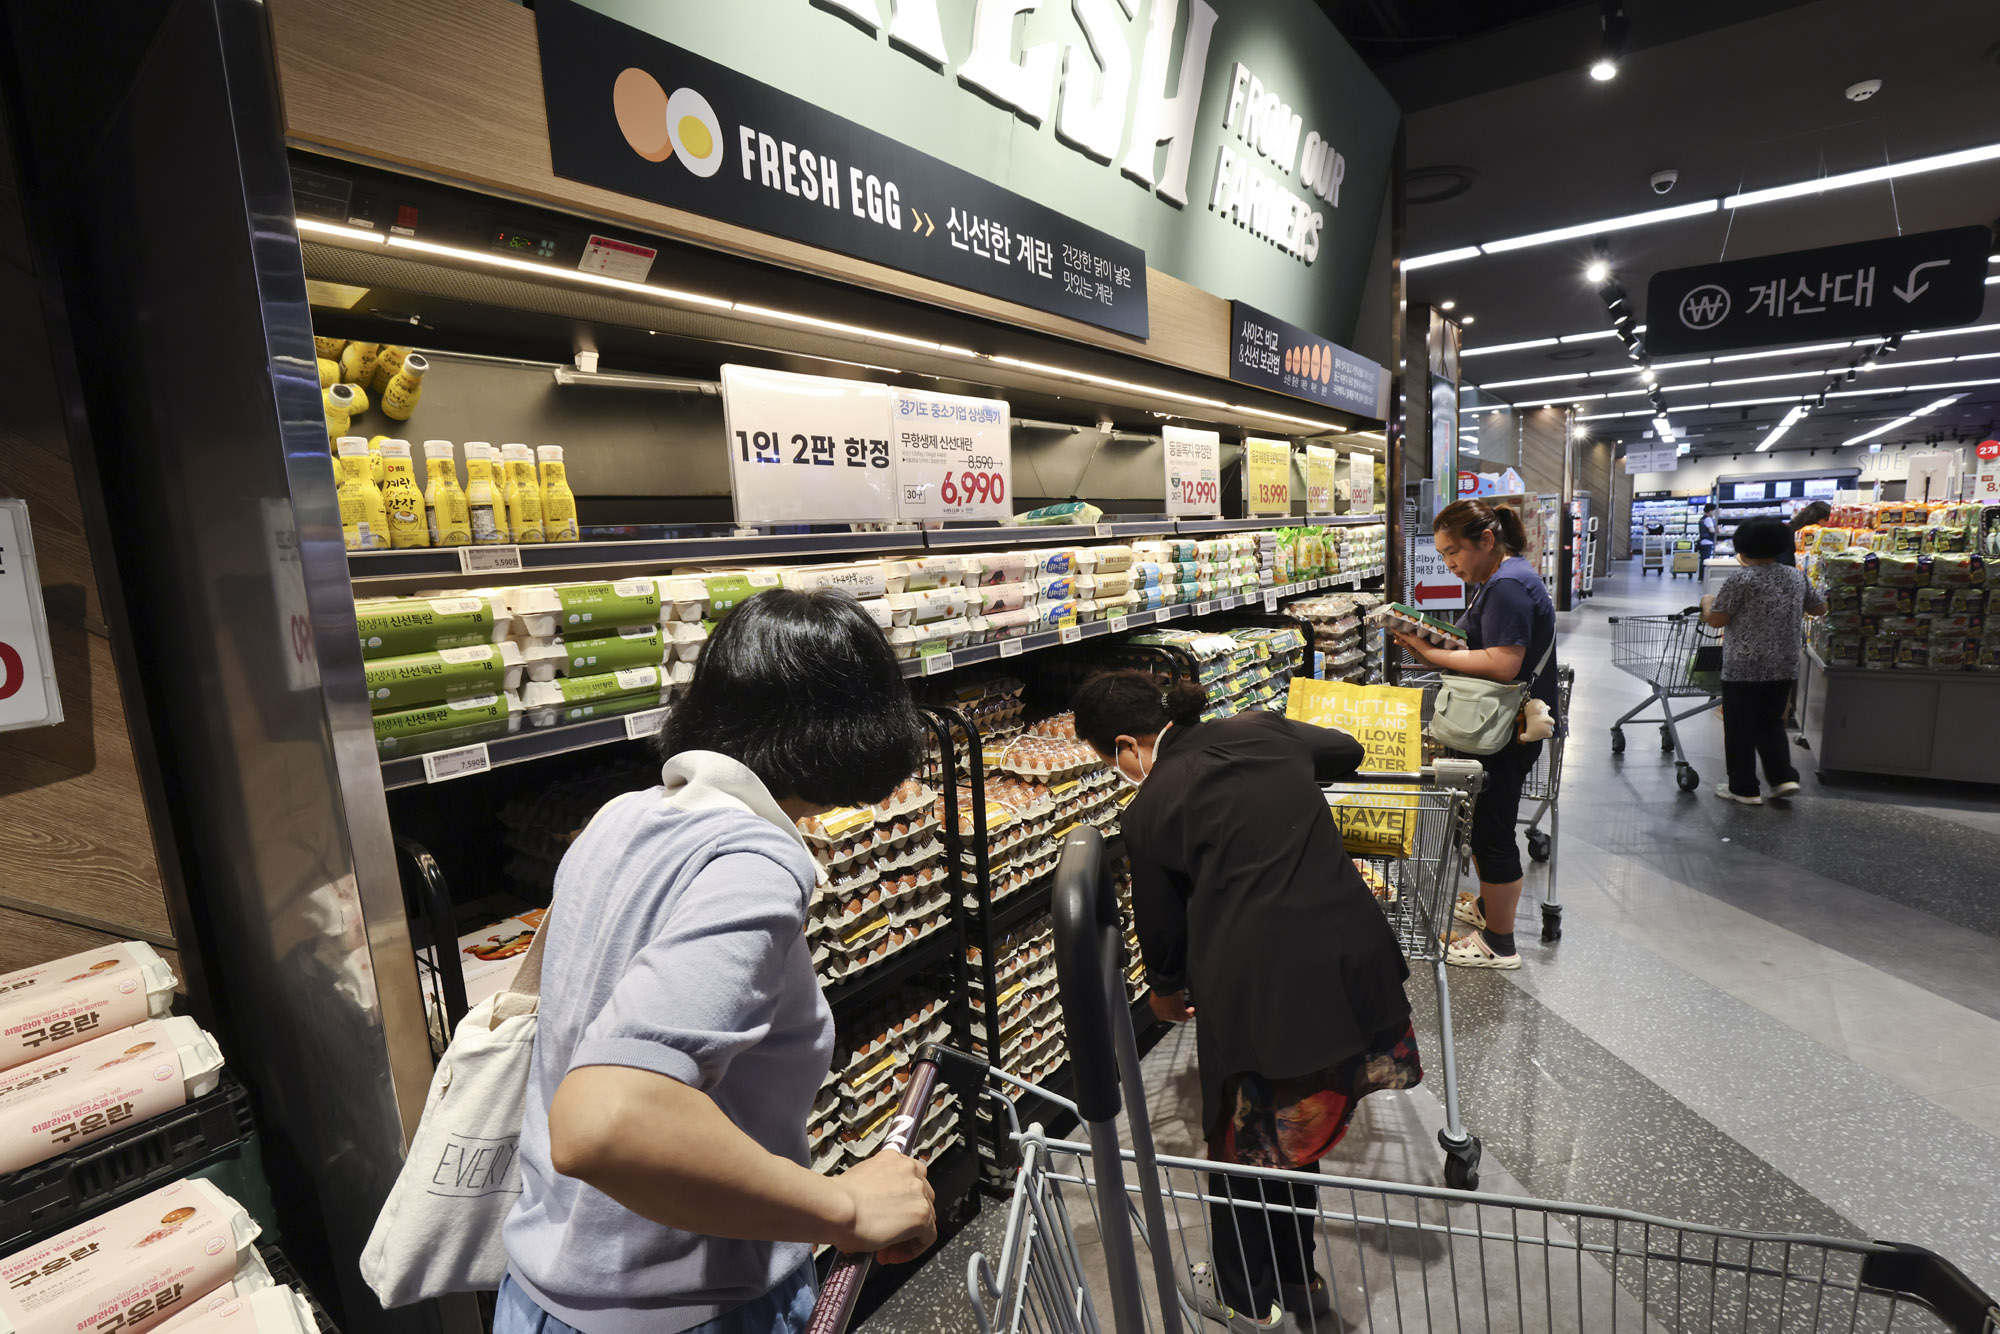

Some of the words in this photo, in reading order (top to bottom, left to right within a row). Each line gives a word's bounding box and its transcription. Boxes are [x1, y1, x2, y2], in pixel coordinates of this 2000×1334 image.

[808, 0, 1219, 206] ESH
[1222, 60, 1303, 175] FROM
[1300, 130, 1346, 208] OUR
[739, 124, 840, 210] FRESH
[850, 166, 902, 230] EGG
[1210, 144, 1324, 264] FARMERS
[946, 206, 1011, 265] 신선한
[1016, 233, 1053, 279] 계란
[1062, 243, 1092, 274] 건강한
[1094, 256, 1112, 282] 닭이
[1114, 264, 1132, 288] 낳은
[1063, 271, 1092, 300] 맛있는
[1095, 283, 1114, 306] 계란
[1745, 266, 1876, 317] 계산대
[1242, 320, 1264, 346] 사이즈
[1265, 330, 1279, 352] 비교
[1260, 352, 1281, 376] 보관법
[899, 399, 929, 416] 경기도
[931, 403, 967, 420] 중소기업
[968, 408, 1001, 425] 상생특가
[736, 430, 781, 464] 1인
[790, 434, 836, 467] 2판
[844, 437, 890, 469] 한정
[901, 432, 938, 449] 무항생제
[939, 435, 973, 452] 신선대란
[1169, 441, 1194, 458] 동물복지
[1194, 443, 1212, 460] 유정란
[1979, 445, 1999, 455] 2개
[967, 455, 994, 470] 8,590
[1857, 452, 1906, 472] SIDE
[386, 477, 411, 490] 계란
[941, 471, 1005, 507] 6,990
[1181, 480, 1217, 506] 12,990
[388, 497, 416, 511] 간장
[1259, 483, 1288, 505] 13,990
[1416, 565, 1434, 575] 매장
[645, 596, 654, 605] 15
[390, 612, 434, 628] 신선특란
[472, 613, 483, 623] 18
[648, 638, 657, 646] 15
[398, 663, 443, 679] 신선특란
[482, 661, 493, 671] 18
[487, 706, 498, 717] 18
[1309, 696, 1336, 709] I'M
[1343, 697, 1408, 716] LITTLE
[404, 709, 448, 727] 신선특란
[1375, 717, 1408, 729] AND
[1365, 731, 1407, 744] LOVE
[461, 757, 487, 769] 7,590원
[1335, 807, 1404, 831] SAVE
[4, 1020, 42, 1036] 히말라야
[22, 1011, 100, 1048] 구운란
[92, 1091, 109, 1103] pink
[32, 1114, 72, 1134] 히말라야
[51, 1101, 135, 1144] 구운란
[9, 1242, 101, 1290] 구운란
[141, 1277, 158, 1291] pink
[77, 1303, 119, 1331] 히말라야
[97, 1282, 185, 1334] 구운란
